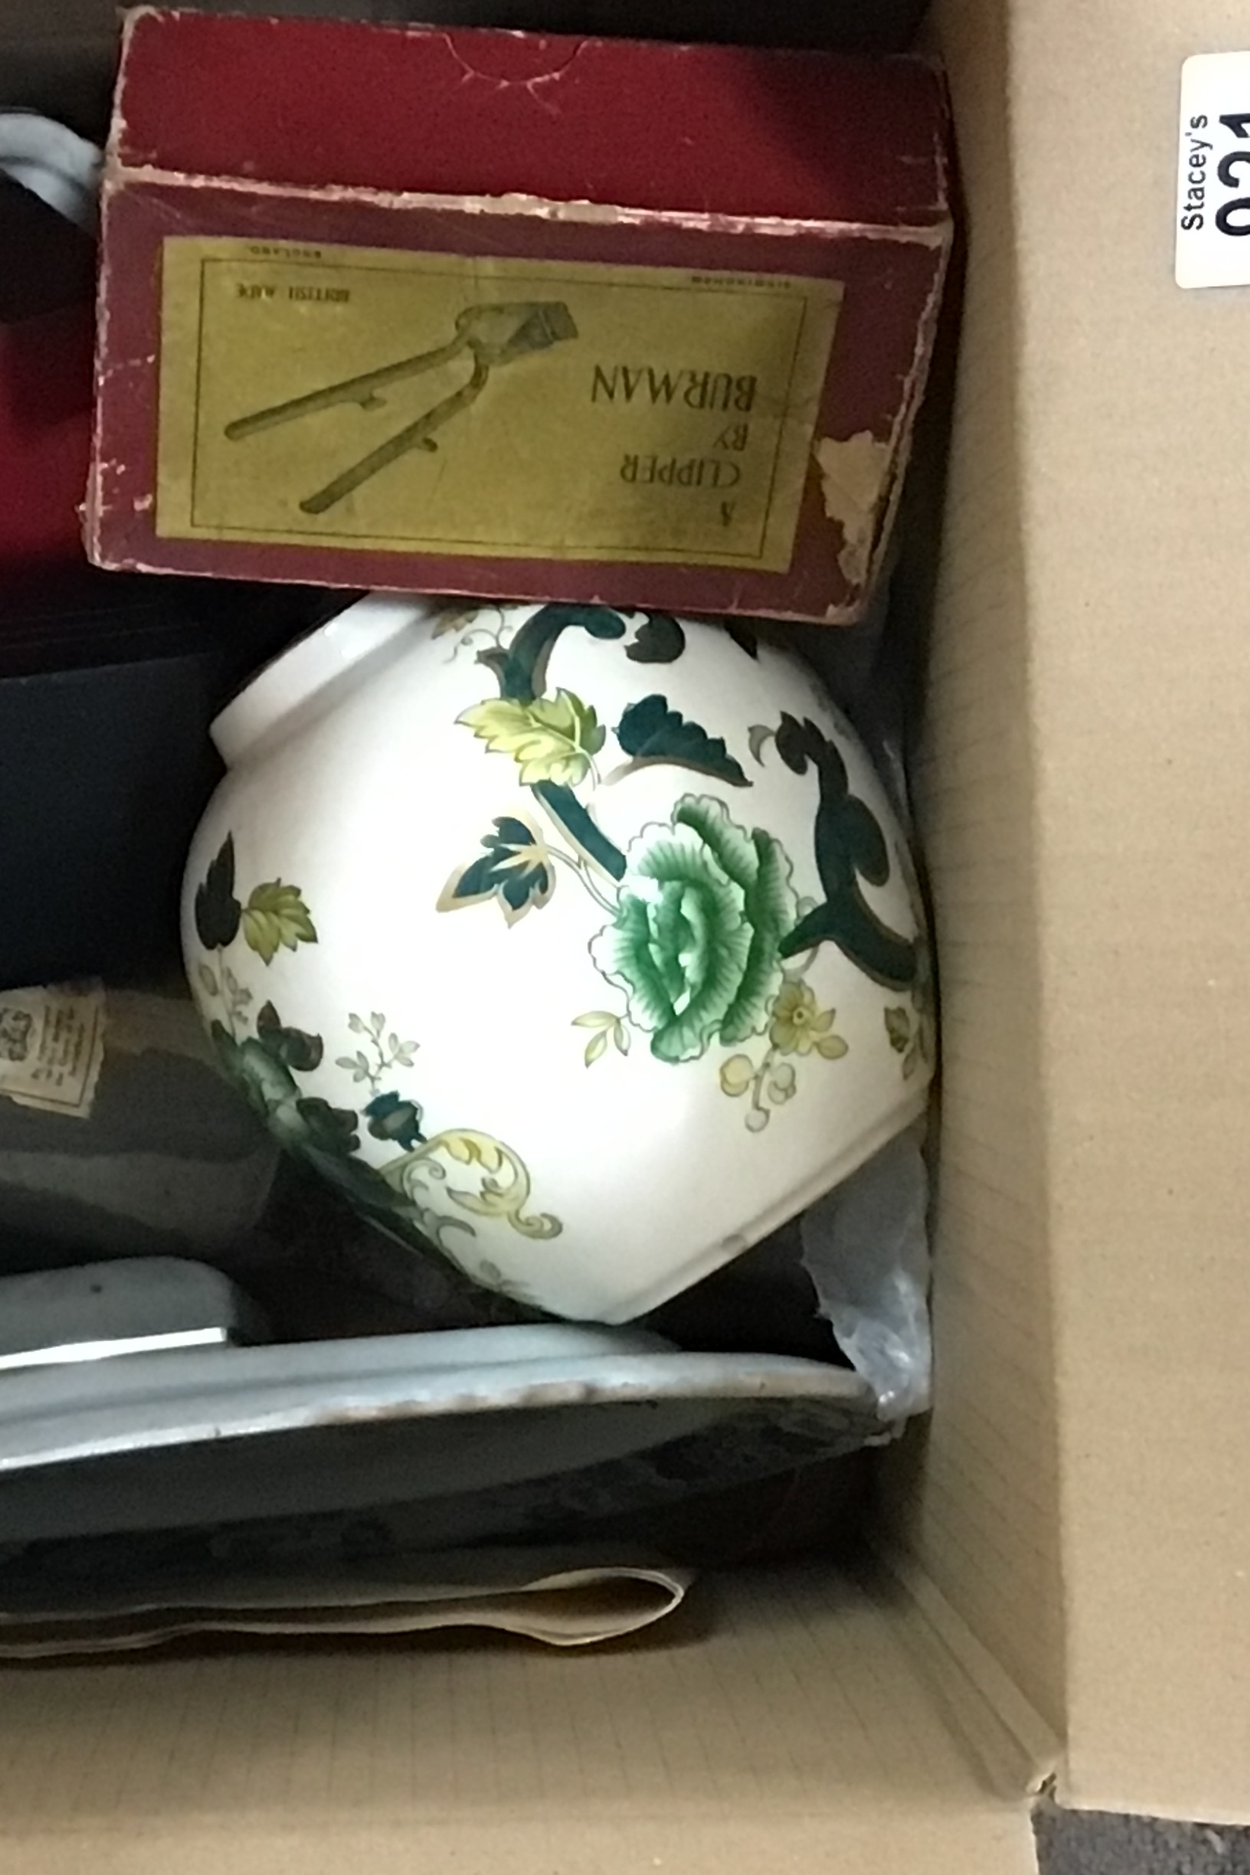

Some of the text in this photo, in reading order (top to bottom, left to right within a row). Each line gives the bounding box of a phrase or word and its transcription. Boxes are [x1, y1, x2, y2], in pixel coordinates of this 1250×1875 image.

[1180, 114, 1213, 231] Stacey's
[589, 364, 758, 413] BURMAN
[713, 423, 749, 453] BY
[619, 453, 742, 490] CLIPPER
[720, 501, 736, 527] A
